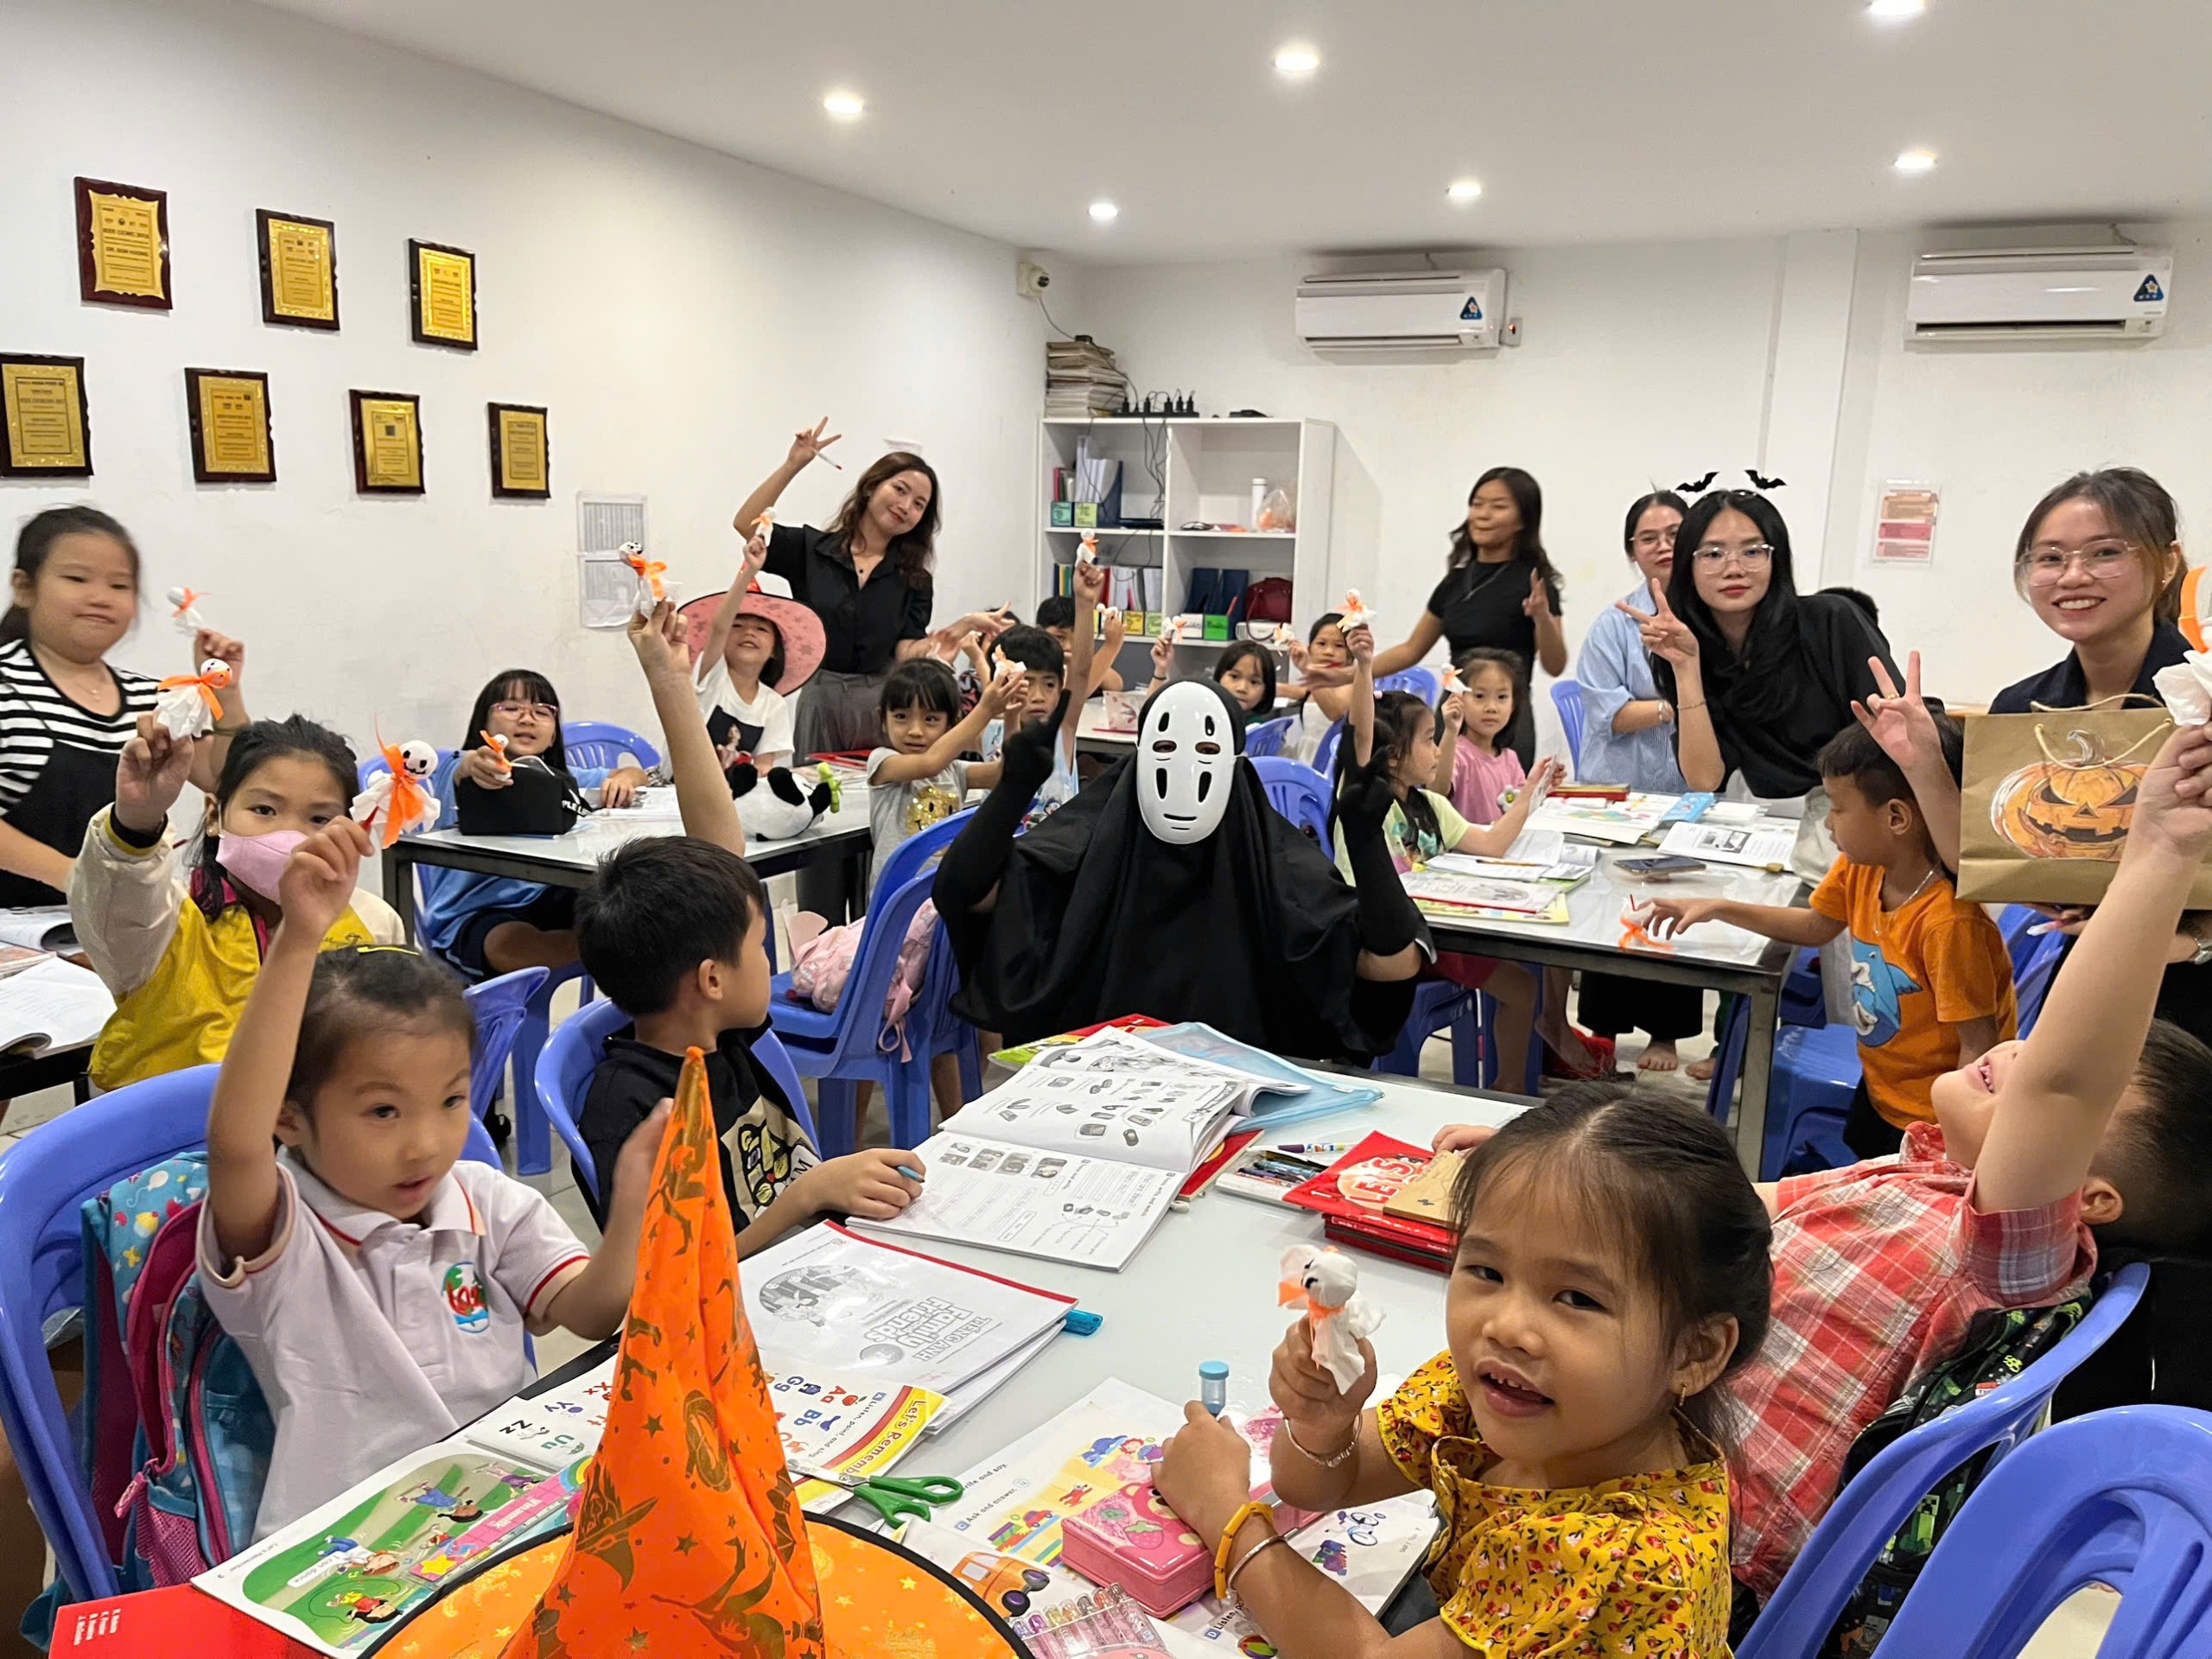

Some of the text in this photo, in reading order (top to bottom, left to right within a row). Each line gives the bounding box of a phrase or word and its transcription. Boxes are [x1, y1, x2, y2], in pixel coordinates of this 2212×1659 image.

[863, 1296, 953, 1343] Friends
[896, 1305, 972, 1349] Family
[843, 1399, 926, 1475] Let's Rememb
[493, 1497, 542, 1529] Vinamilk
[966, 1511, 981, 1522] Ask
[980, 1503, 994, 1513] and
